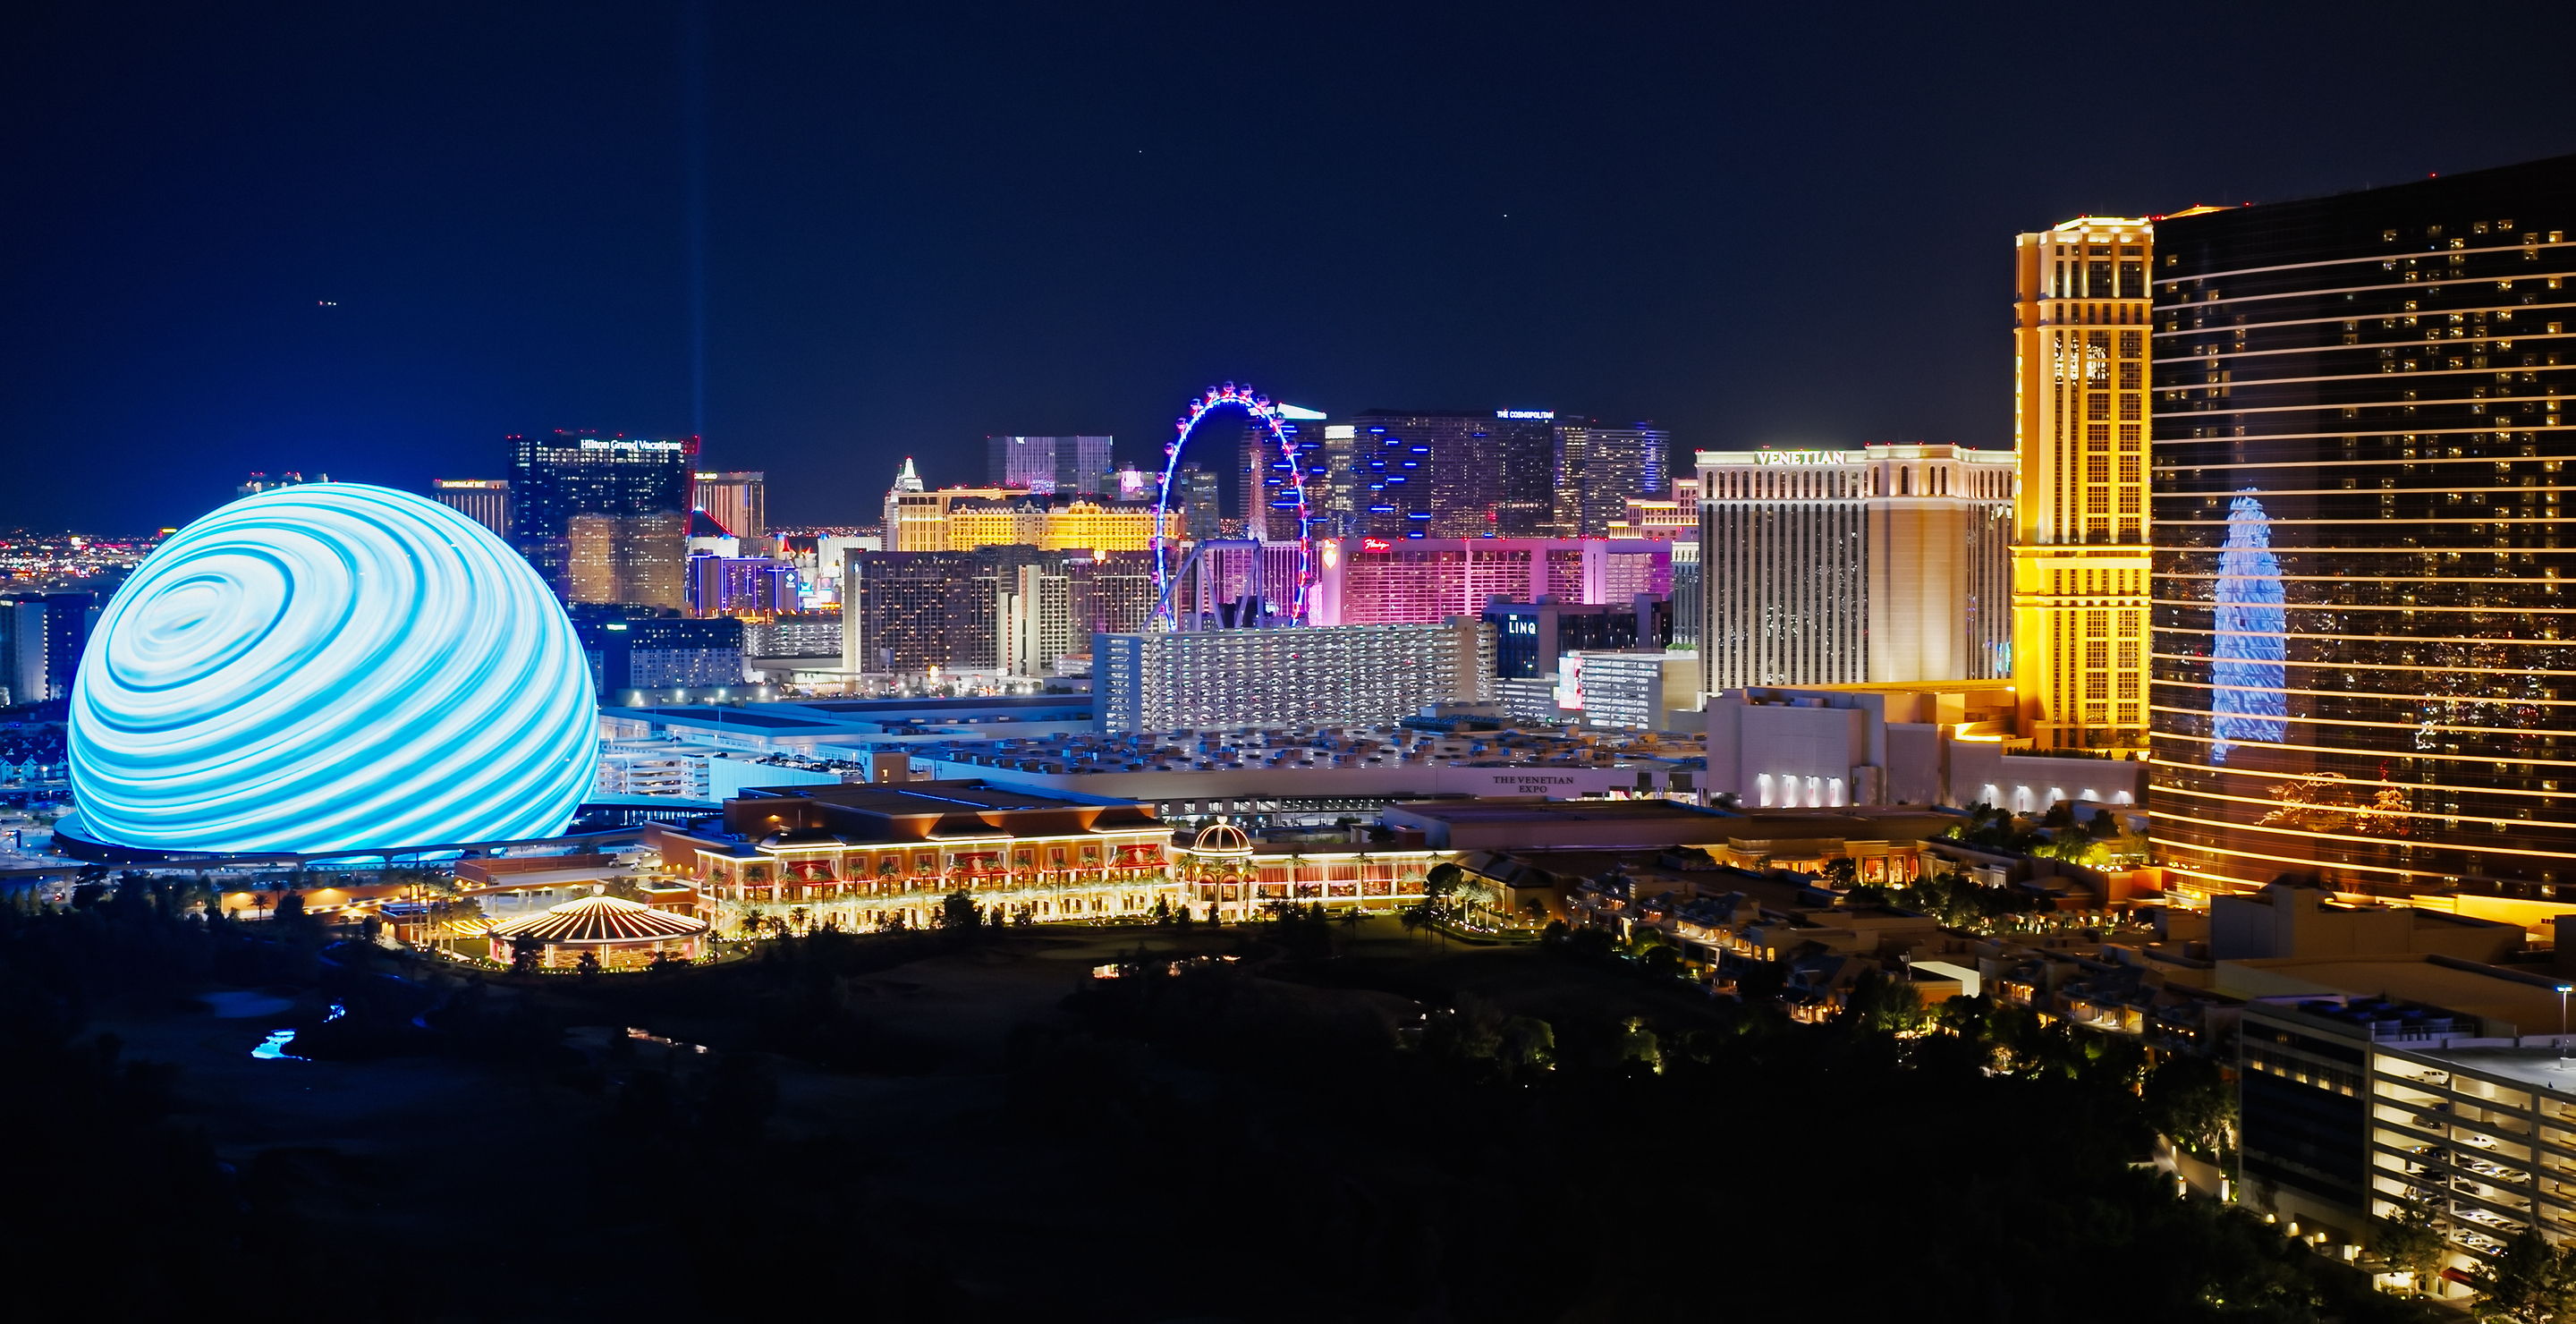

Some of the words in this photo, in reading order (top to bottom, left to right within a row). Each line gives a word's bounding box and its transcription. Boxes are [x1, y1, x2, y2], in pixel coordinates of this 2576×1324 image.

[1496, 411, 1509, 419] THE
[1509, 411, 1555, 420] COSMOPOLITAN
[580, 439, 609, 449] Hilton
[610, 439, 639, 449] Grand
[639, 440, 682, 450] Vacations
[1756, 450, 1846, 465] VENETIAN
[442, 480, 474, 488] MANDALAY
[1509, 622, 1537, 635] LINQ
[1493, 776, 1516, 784] THE
[1517, 776, 1574, 785] VENETIAN
[1519, 785, 1547, 794] EXPO
